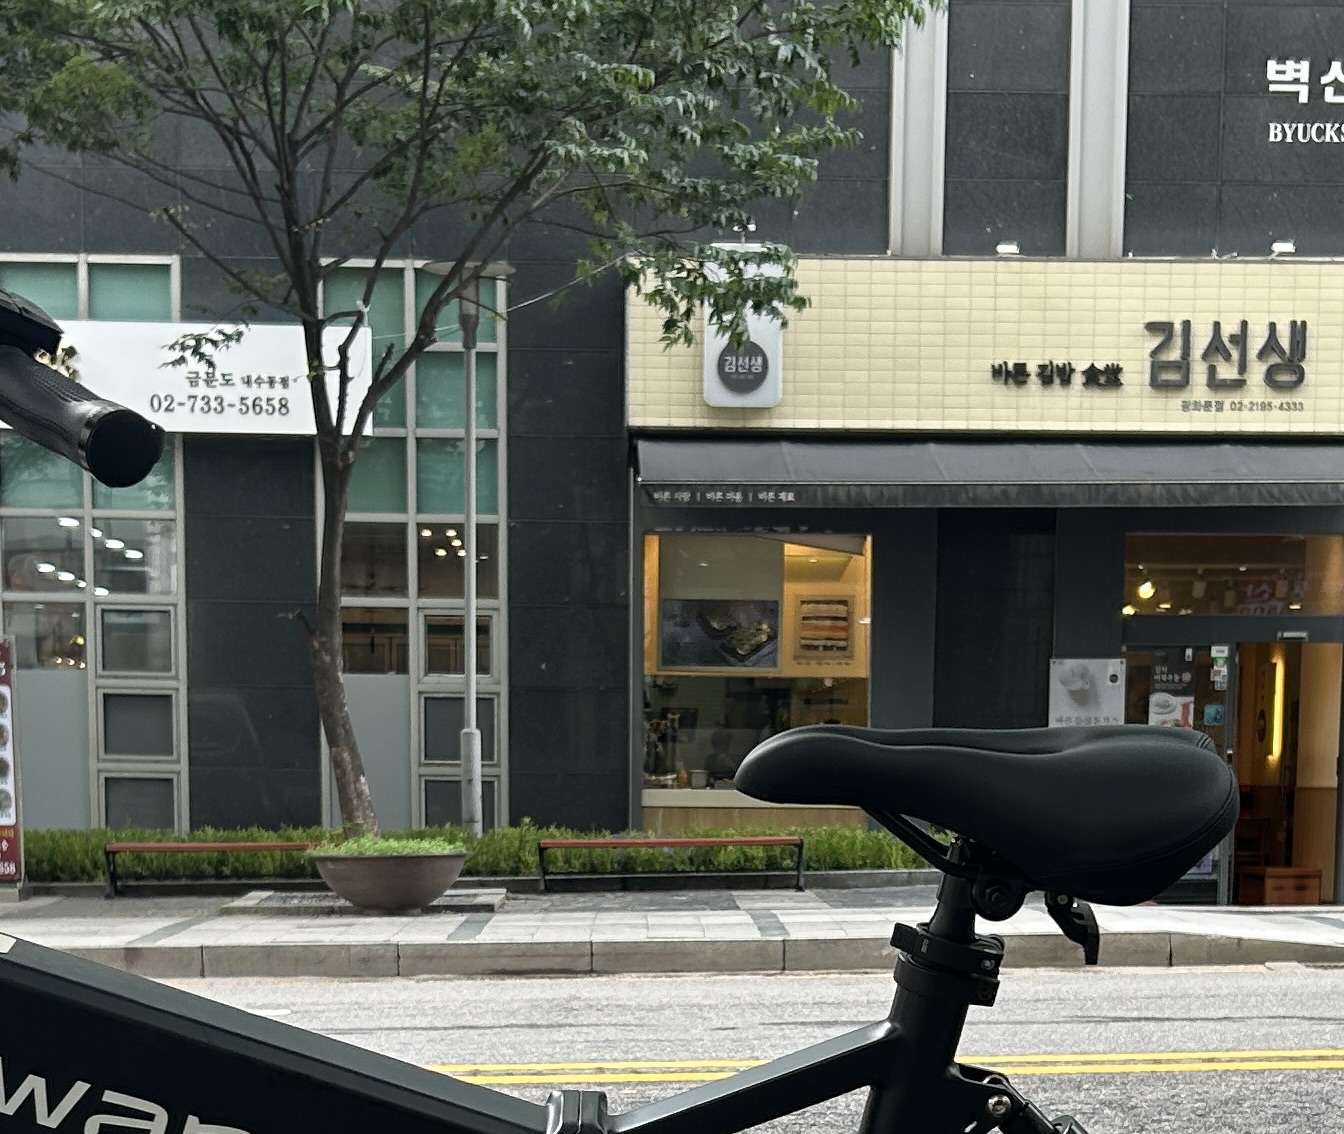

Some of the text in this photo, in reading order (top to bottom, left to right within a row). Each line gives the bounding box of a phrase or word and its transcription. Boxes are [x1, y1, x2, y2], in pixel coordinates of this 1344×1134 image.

[723, 355, 763, 374] 김선생
[1143, 319, 1308, 390] 김선생
[991, 360, 1031, 386] 바른
[1036, 360, 1076, 386] 김밥
[149, 393, 291, 417] 02-733-5658
